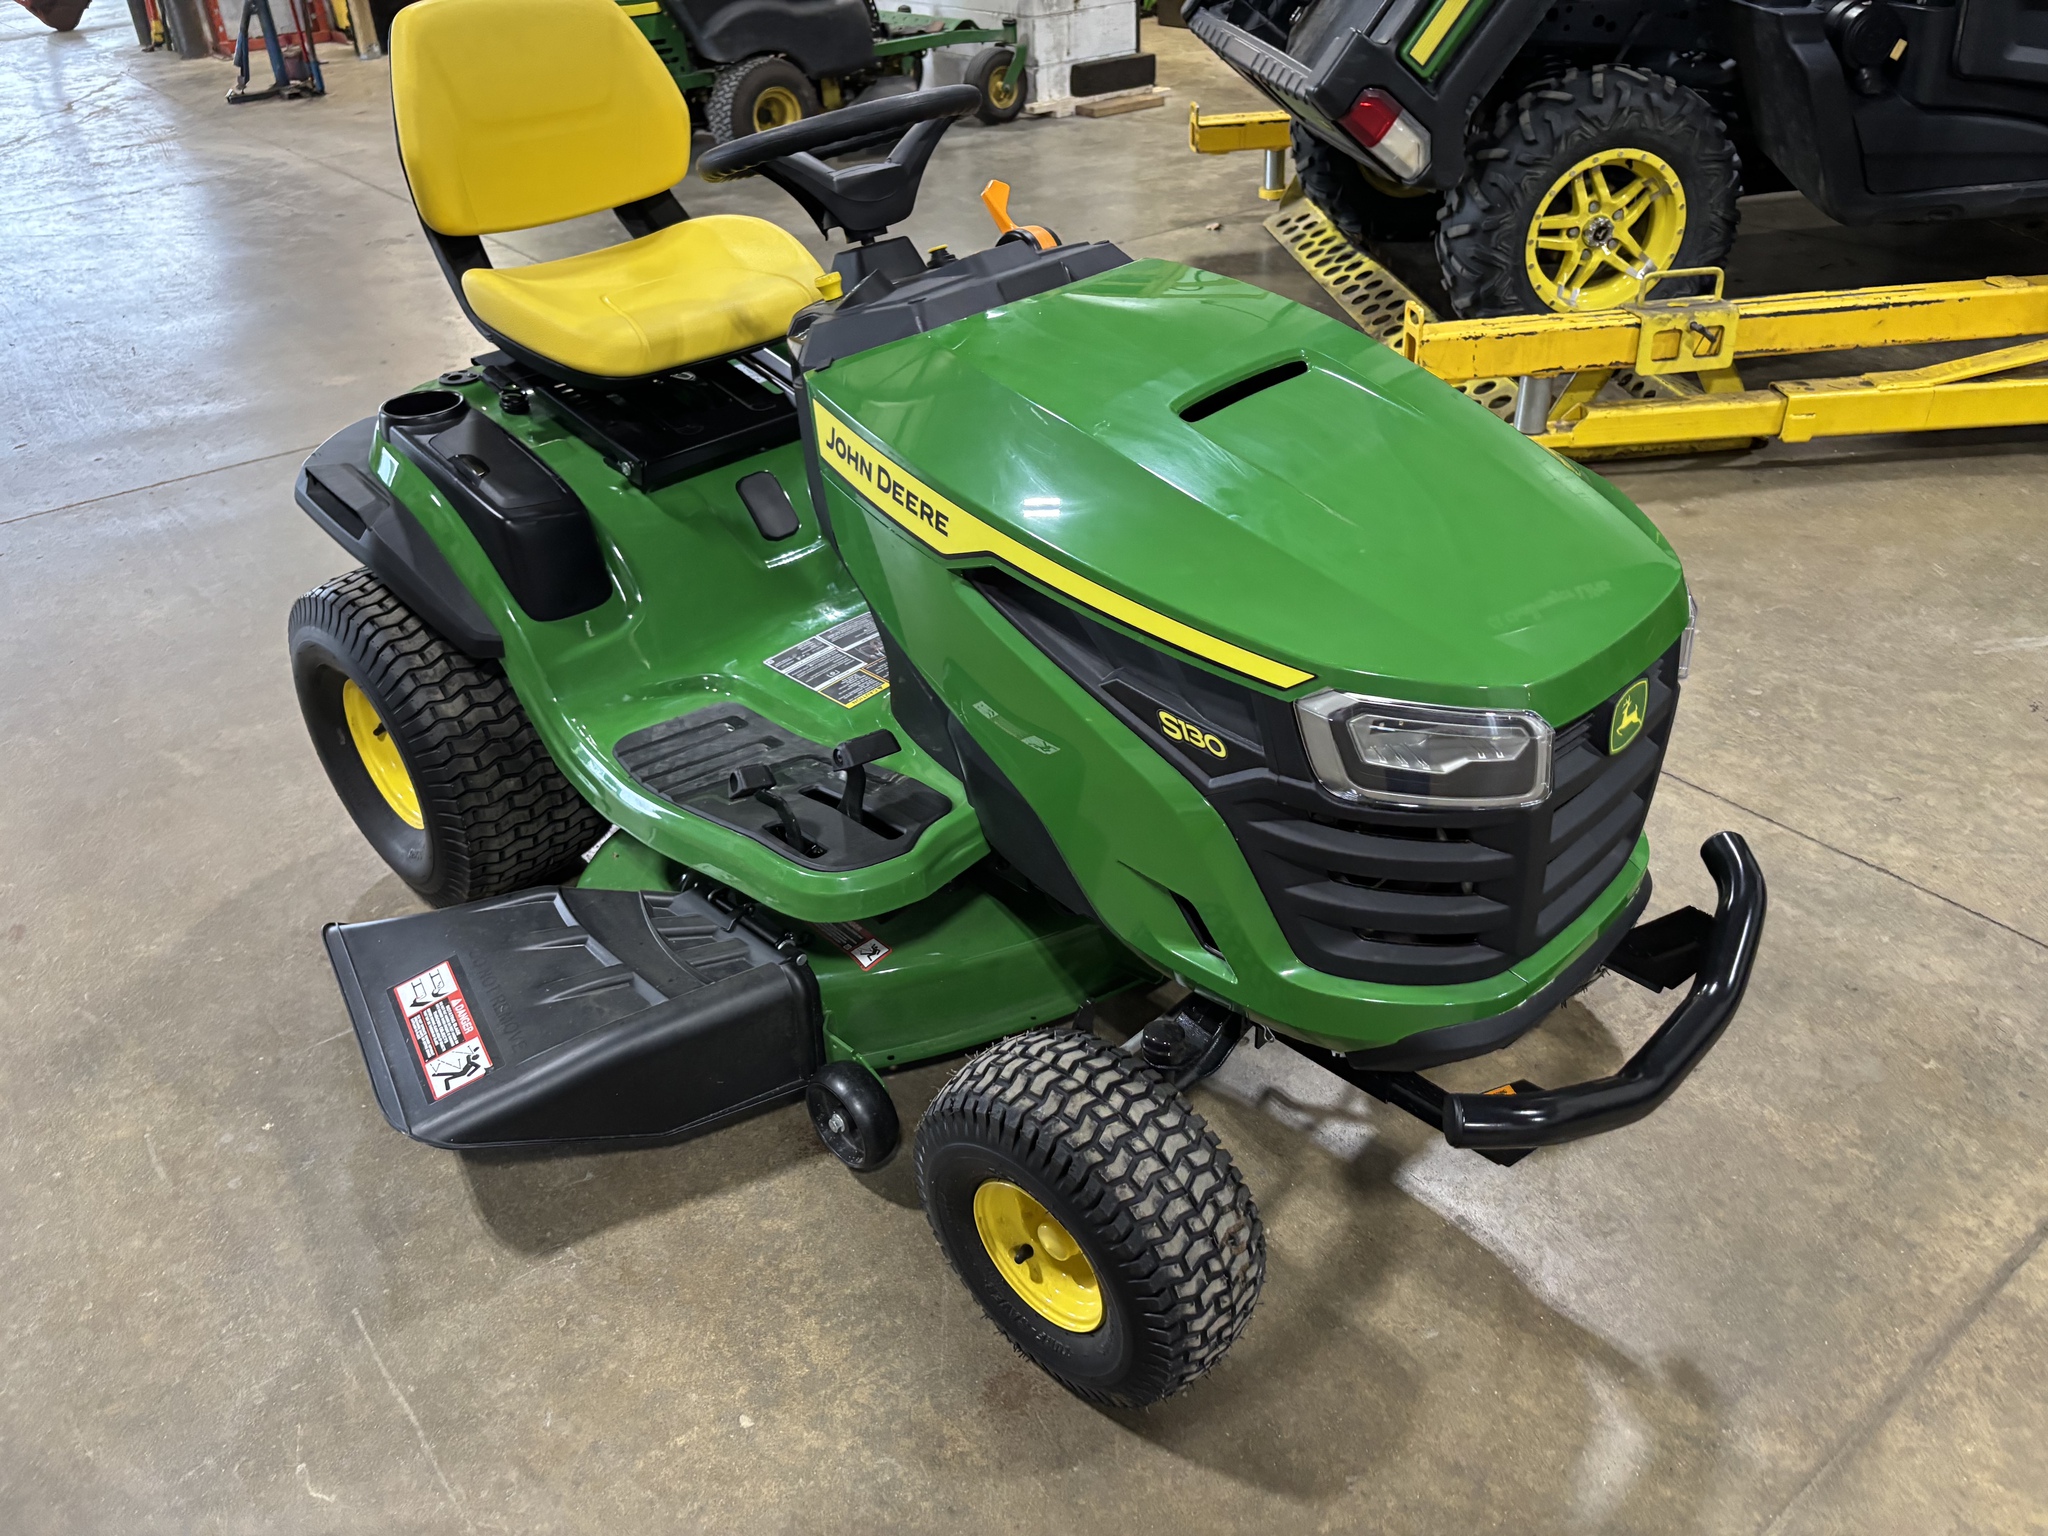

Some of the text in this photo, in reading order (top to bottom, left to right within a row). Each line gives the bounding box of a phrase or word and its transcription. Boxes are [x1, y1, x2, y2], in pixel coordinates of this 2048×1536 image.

[826, 427, 949, 537] JOHN DEERE
[1158, 710, 1227, 758] S130
[455, 1004, 474, 1034] DANGER
